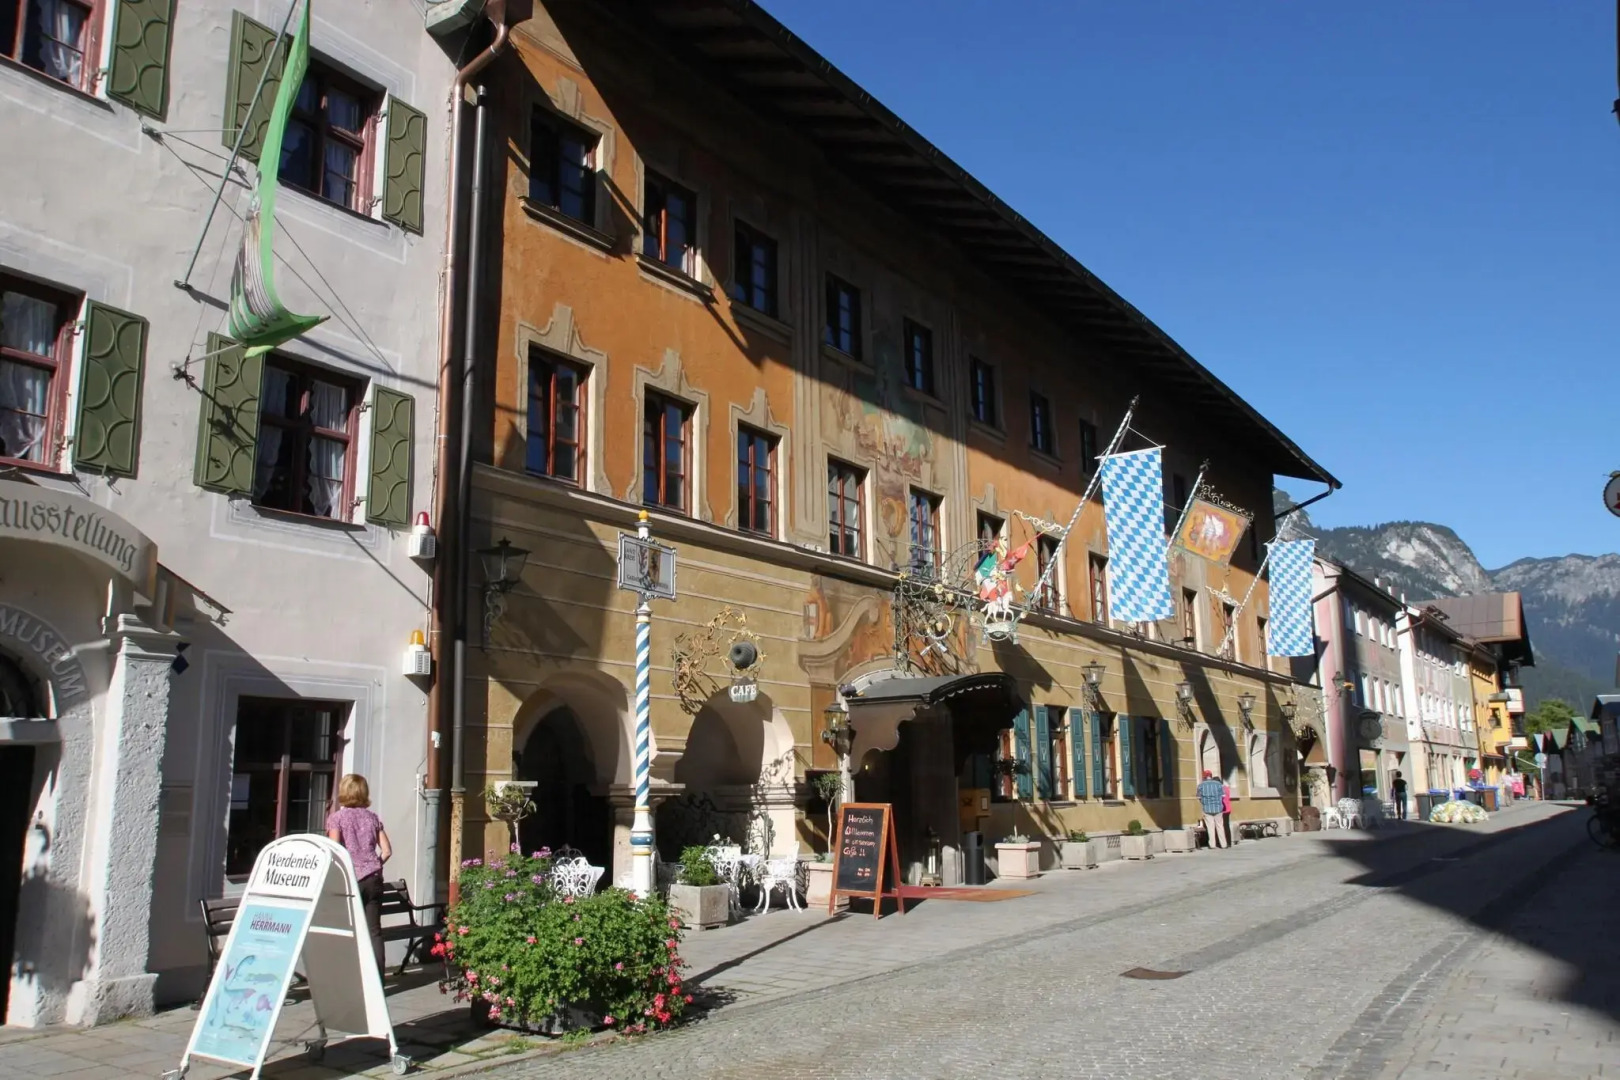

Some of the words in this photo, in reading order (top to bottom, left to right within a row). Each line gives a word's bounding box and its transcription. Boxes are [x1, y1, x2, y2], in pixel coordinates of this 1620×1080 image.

[267, 852, 320, 871] Werdenfels
[263, 869, 311, 888] Museum
[249, 919, 293, 935] HERRMANN
